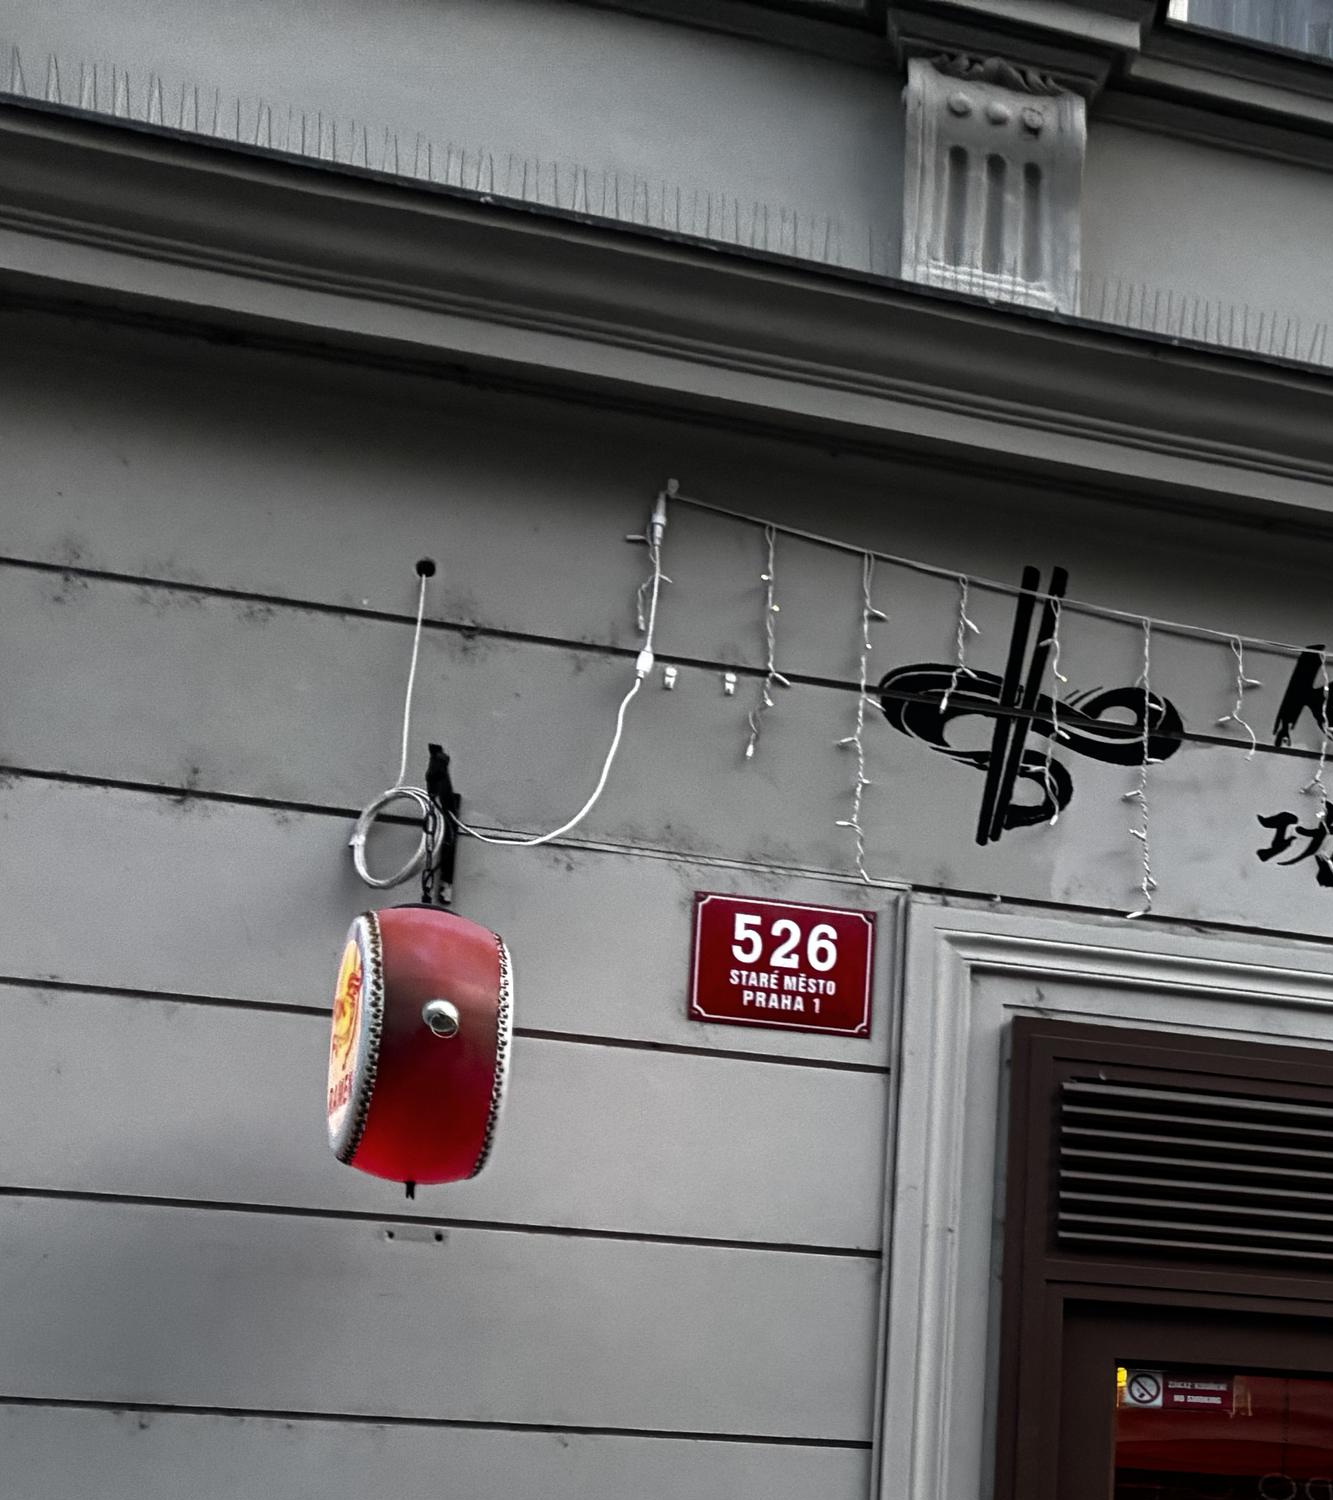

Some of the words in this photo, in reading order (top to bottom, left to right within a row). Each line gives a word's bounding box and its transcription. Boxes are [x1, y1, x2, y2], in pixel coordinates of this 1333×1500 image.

[732, 913, 838, 972] 526
[729, 969, 778, 990] STARÉ
[784, 973, 836, 996] MĚSTO
[743, 990, 804, 1012] PRAHA
[813, 998, 820, 1014] 1
